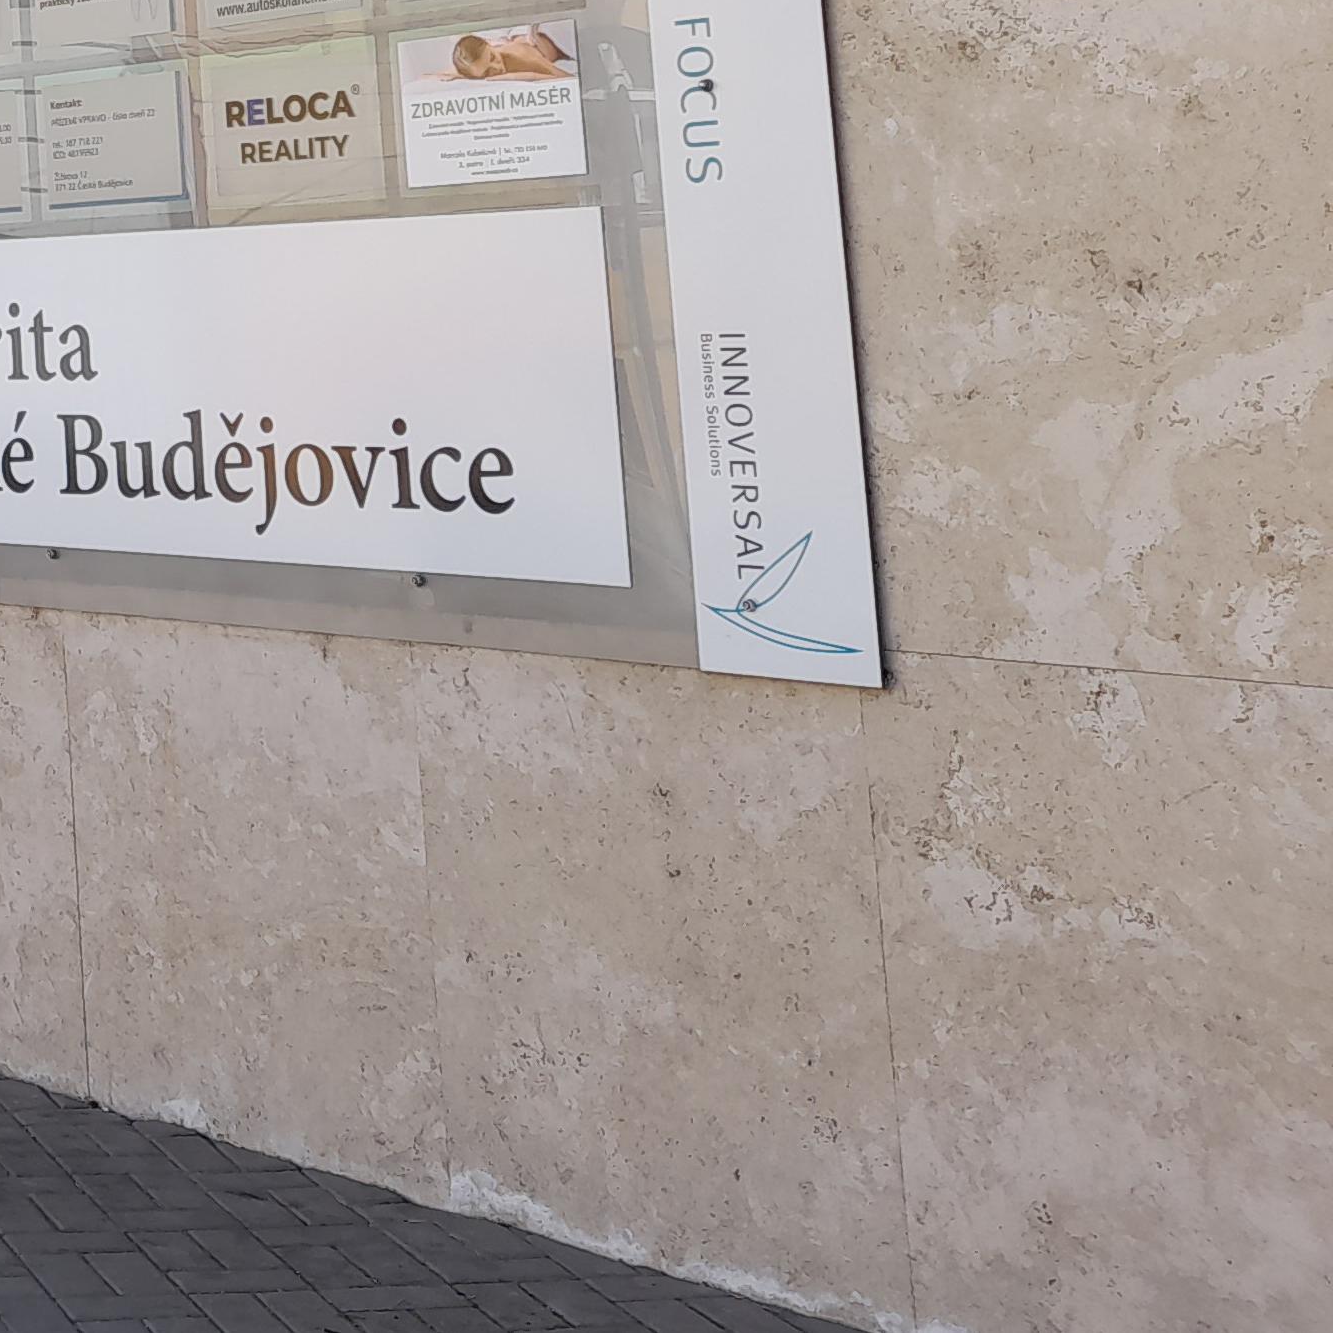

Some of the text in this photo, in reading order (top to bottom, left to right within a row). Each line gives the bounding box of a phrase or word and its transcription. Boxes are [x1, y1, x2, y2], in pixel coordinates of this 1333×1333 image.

[240, 134, 350, 165] REALITY
[411, 85, 572, 119] ZDRAVOTNÍ MASÉR
[673, 15, 723, 184] FOCUS
[57, 408, 517, 536] Budějovice
[699, 332, 722, 478] Business Solutions
[717, 331, 765, 581] INNOVERSAL
